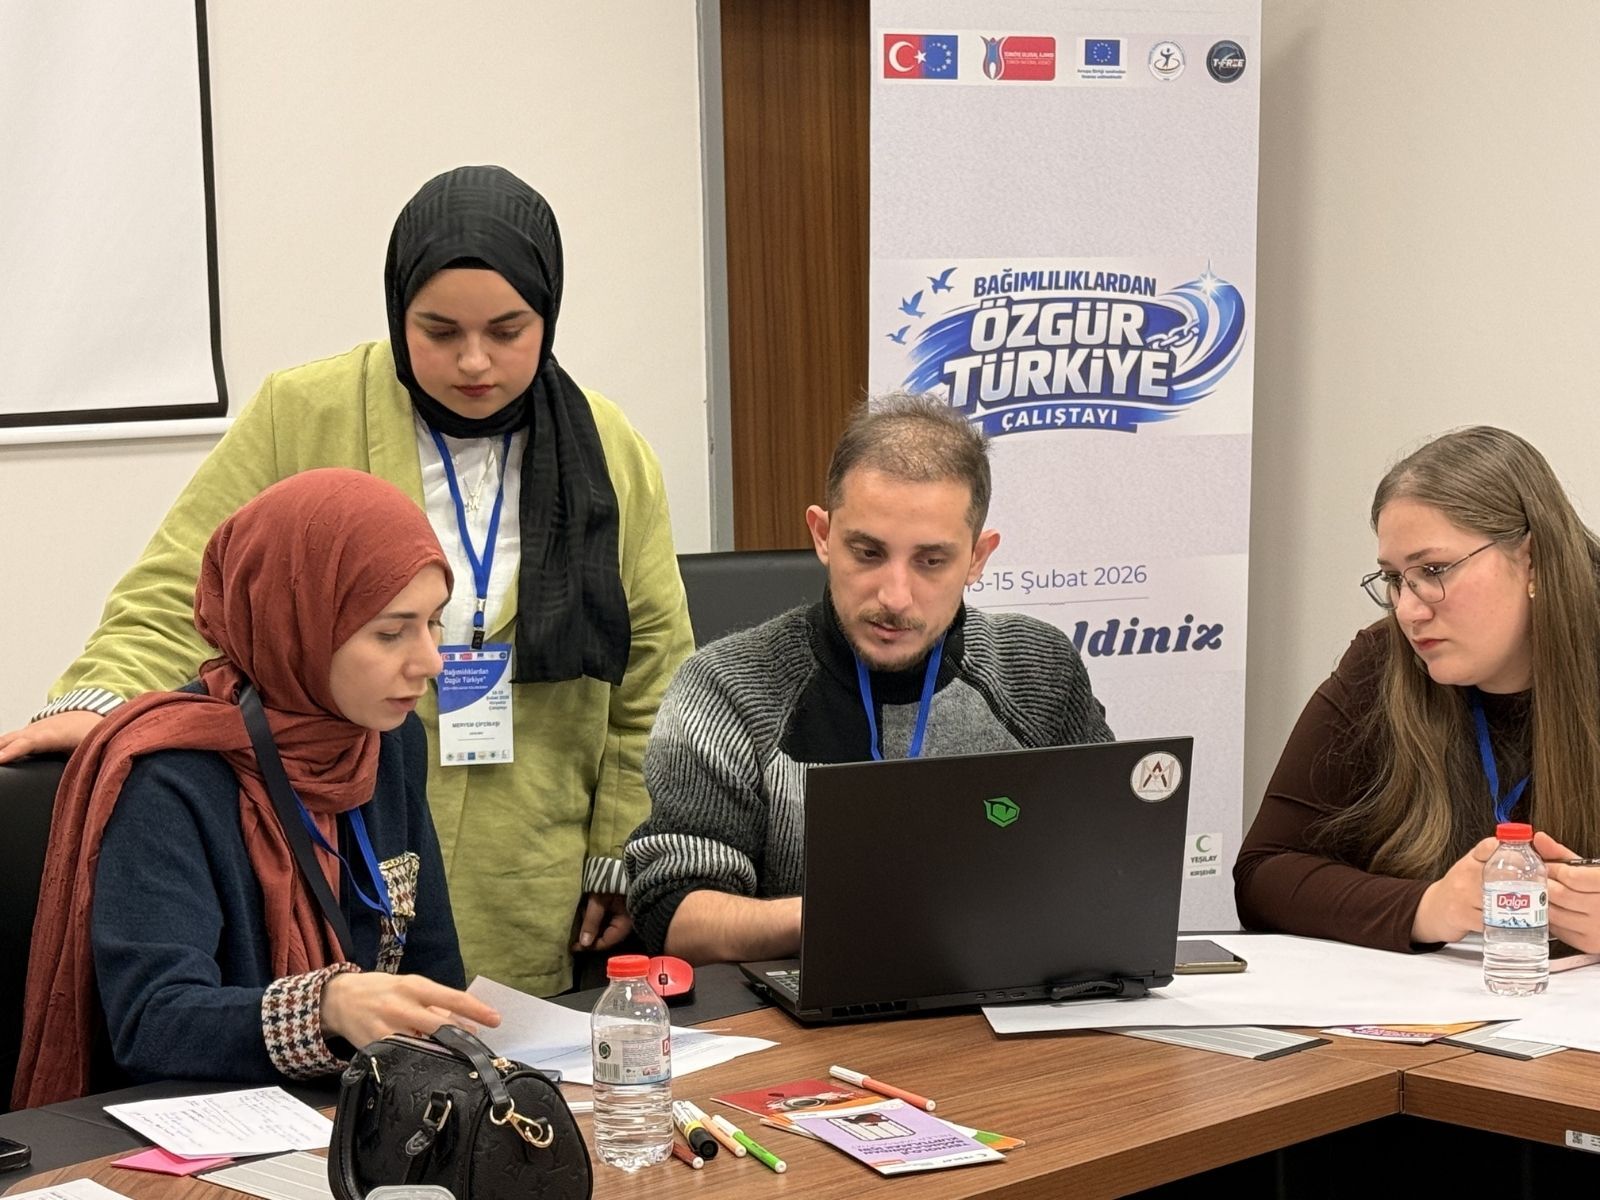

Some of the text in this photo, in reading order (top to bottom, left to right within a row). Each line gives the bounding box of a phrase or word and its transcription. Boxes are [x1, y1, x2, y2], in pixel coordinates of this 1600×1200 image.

[974, 268, 1157, 298] BAĞIMLILIKLARDAN
[970, 298, 1146, 352] ÖZGÜR
[943, 348, 1170, 408] TÜRKİYE
[1001, 408, 1118, 430] ÇALIŞTAYI
[1020, 569, 1088, 595] Şubat
[1093, 565, 1148, 586] 2026
[1498, 895, 1529, 910] Dalga
